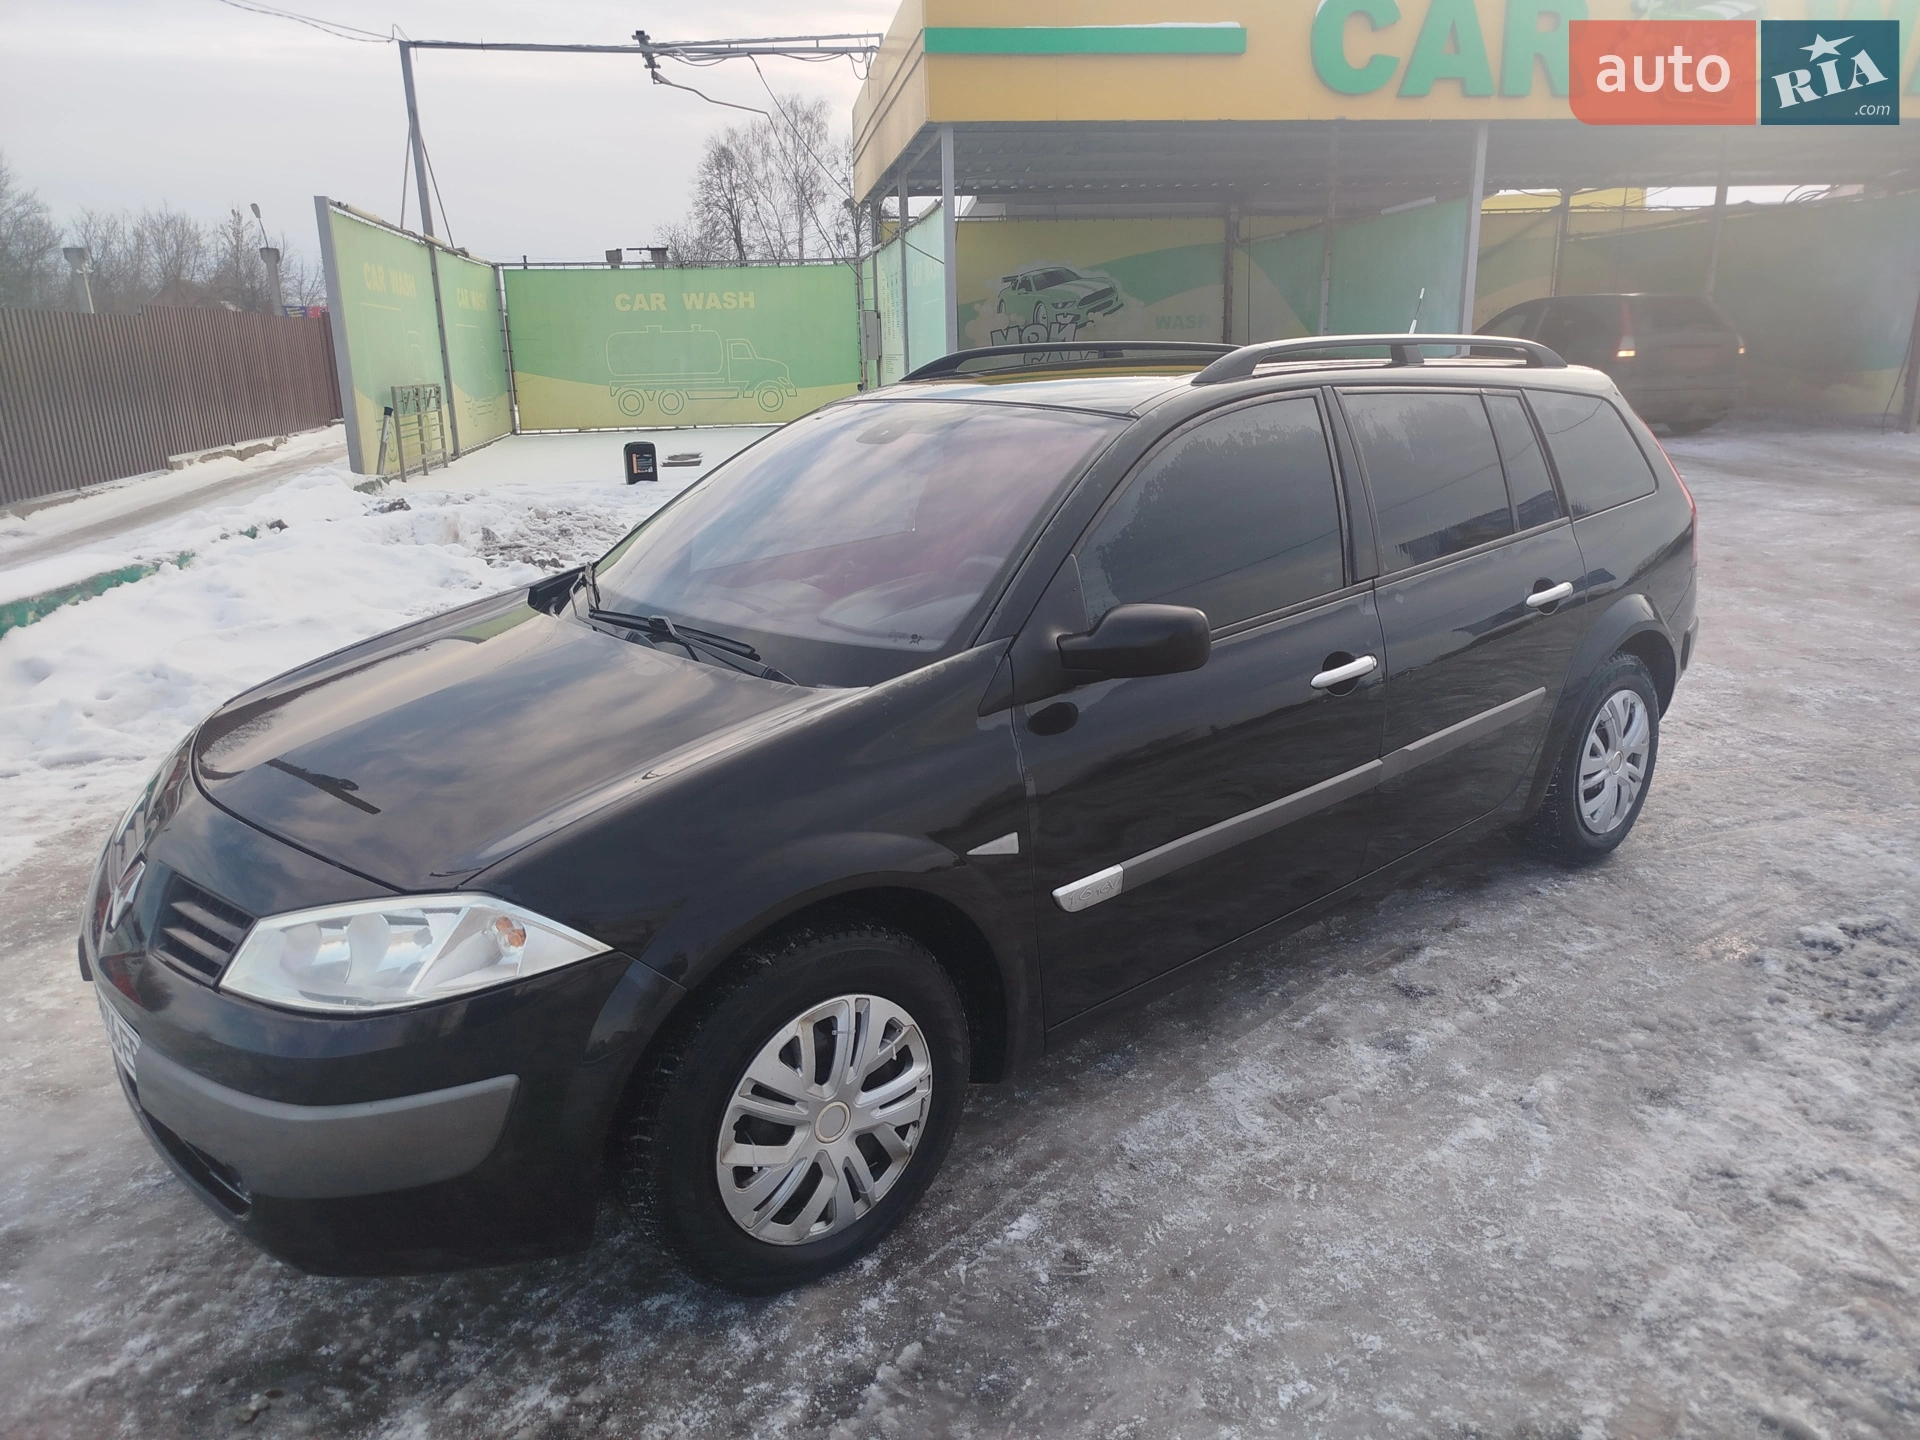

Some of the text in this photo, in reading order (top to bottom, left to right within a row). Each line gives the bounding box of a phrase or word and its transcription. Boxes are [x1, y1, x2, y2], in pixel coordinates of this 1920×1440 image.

[1311, 0, 1588, 96] CAR
[363, 262, 417, 298] CAR WASH
[456, 287, 470, 310] CAR
[614, 291, 756, 312] CAR WASH
[1155, 316, 1210, 330] WASH
